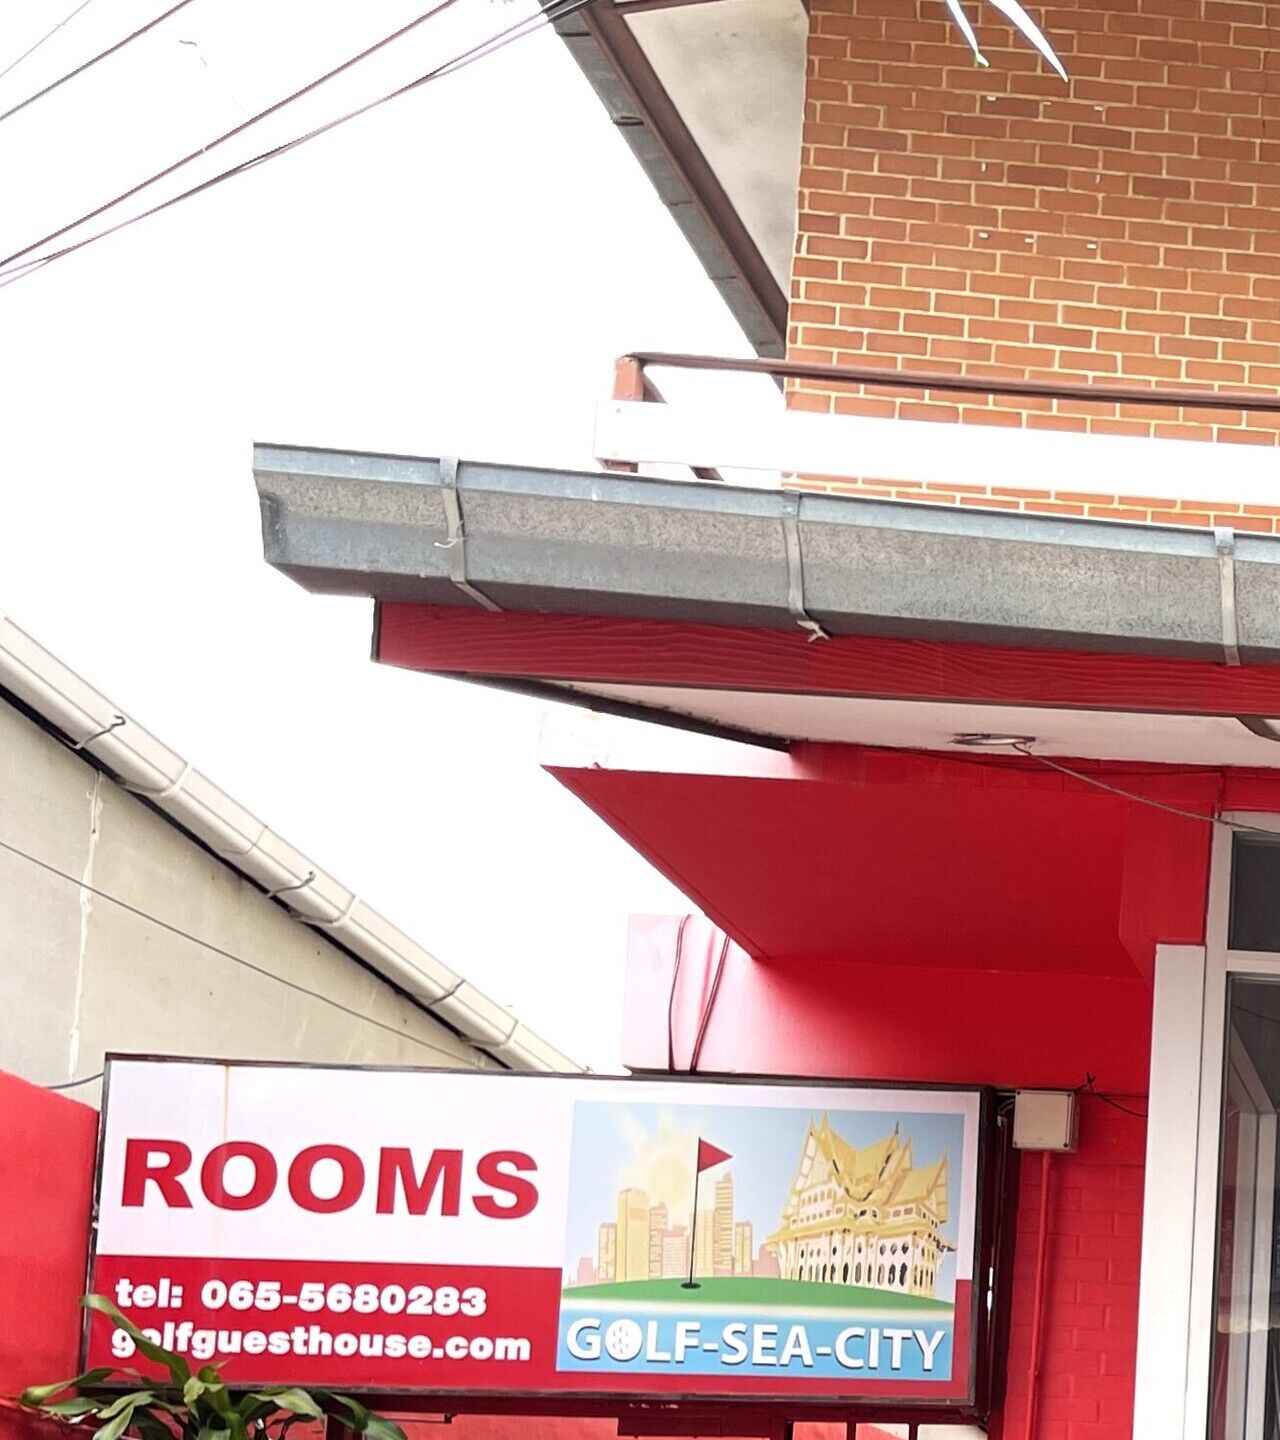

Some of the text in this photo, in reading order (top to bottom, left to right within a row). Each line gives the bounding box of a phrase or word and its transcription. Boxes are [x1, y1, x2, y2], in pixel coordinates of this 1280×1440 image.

[120, 1137, 540, 1220] ROOMS
[114, 1277, 488, 1317] tel: 065-5680283
[565, 1317, 946, 1372] GOLF-SEA-CITY
